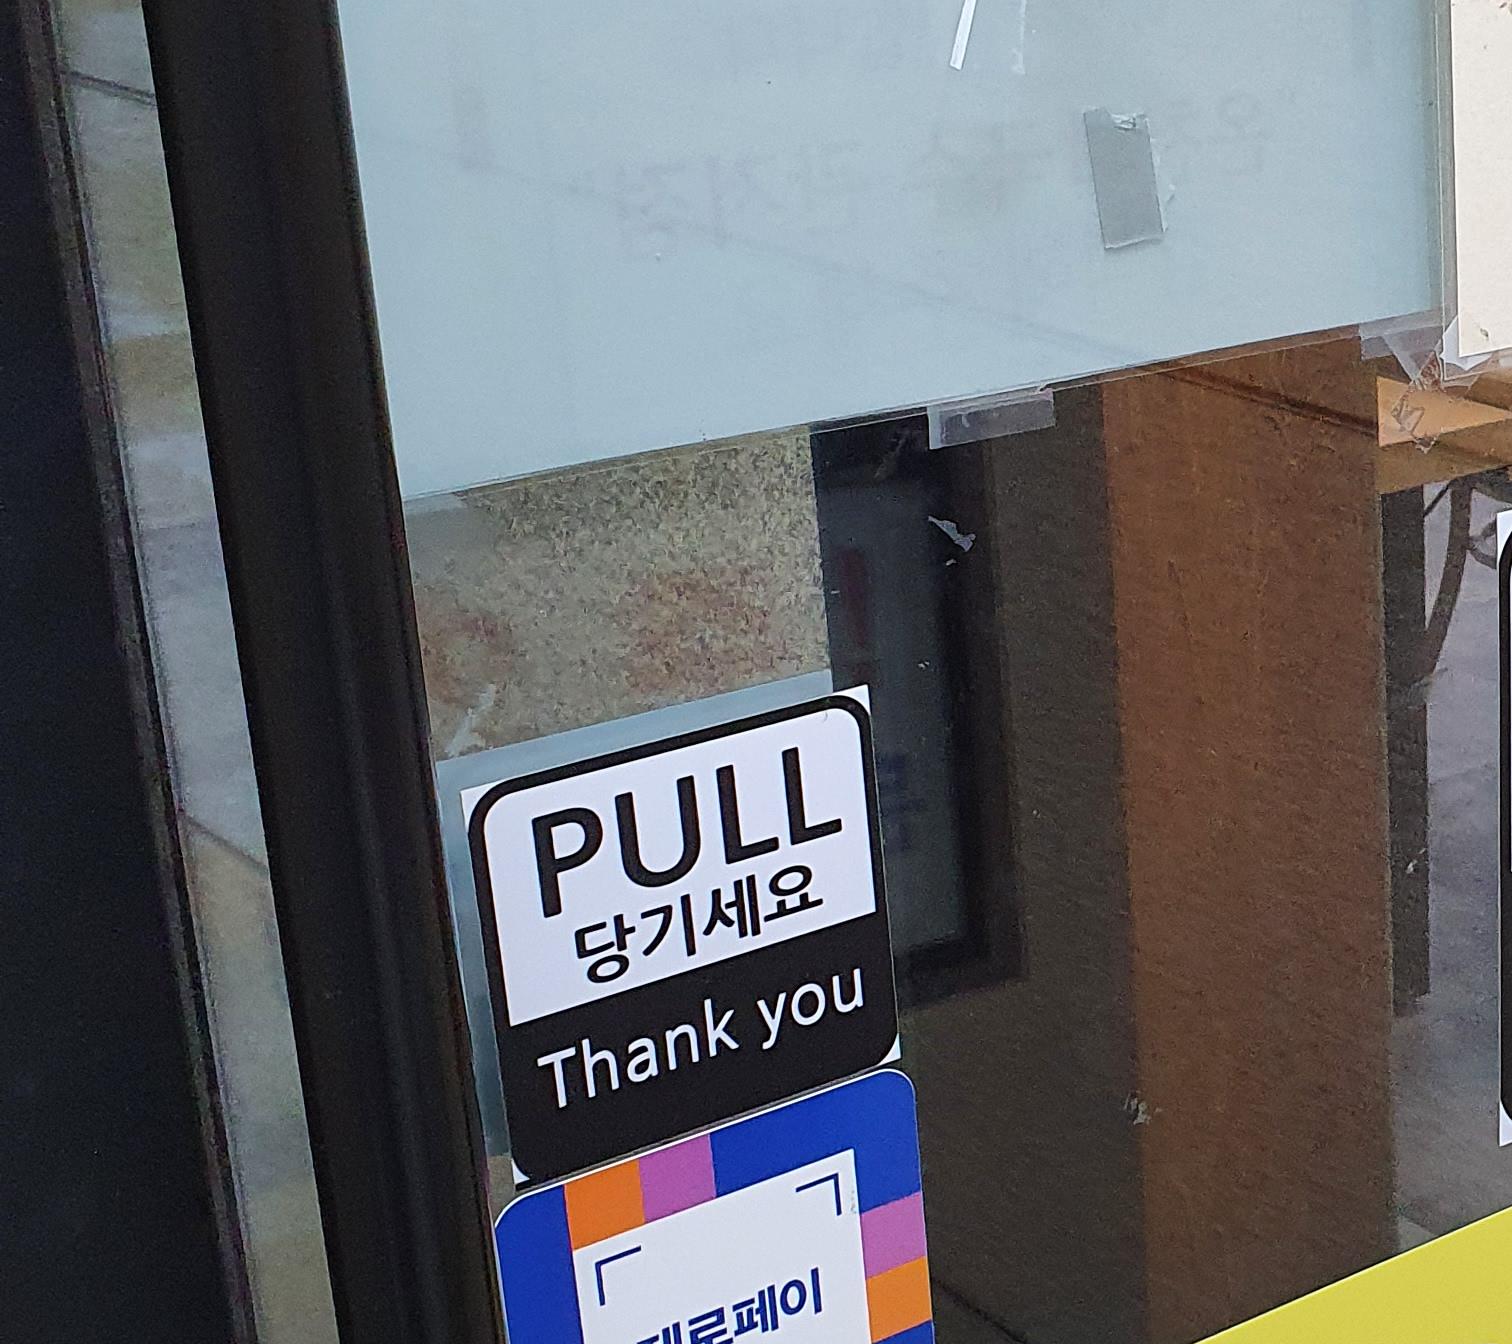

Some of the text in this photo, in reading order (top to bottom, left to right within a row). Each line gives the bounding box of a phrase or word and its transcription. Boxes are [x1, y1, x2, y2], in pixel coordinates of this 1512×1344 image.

[531, 747, 842, 918] PULL
[574, 865, 823, 983] 당기세요
[537, 968, 863, 1108] Thank you
